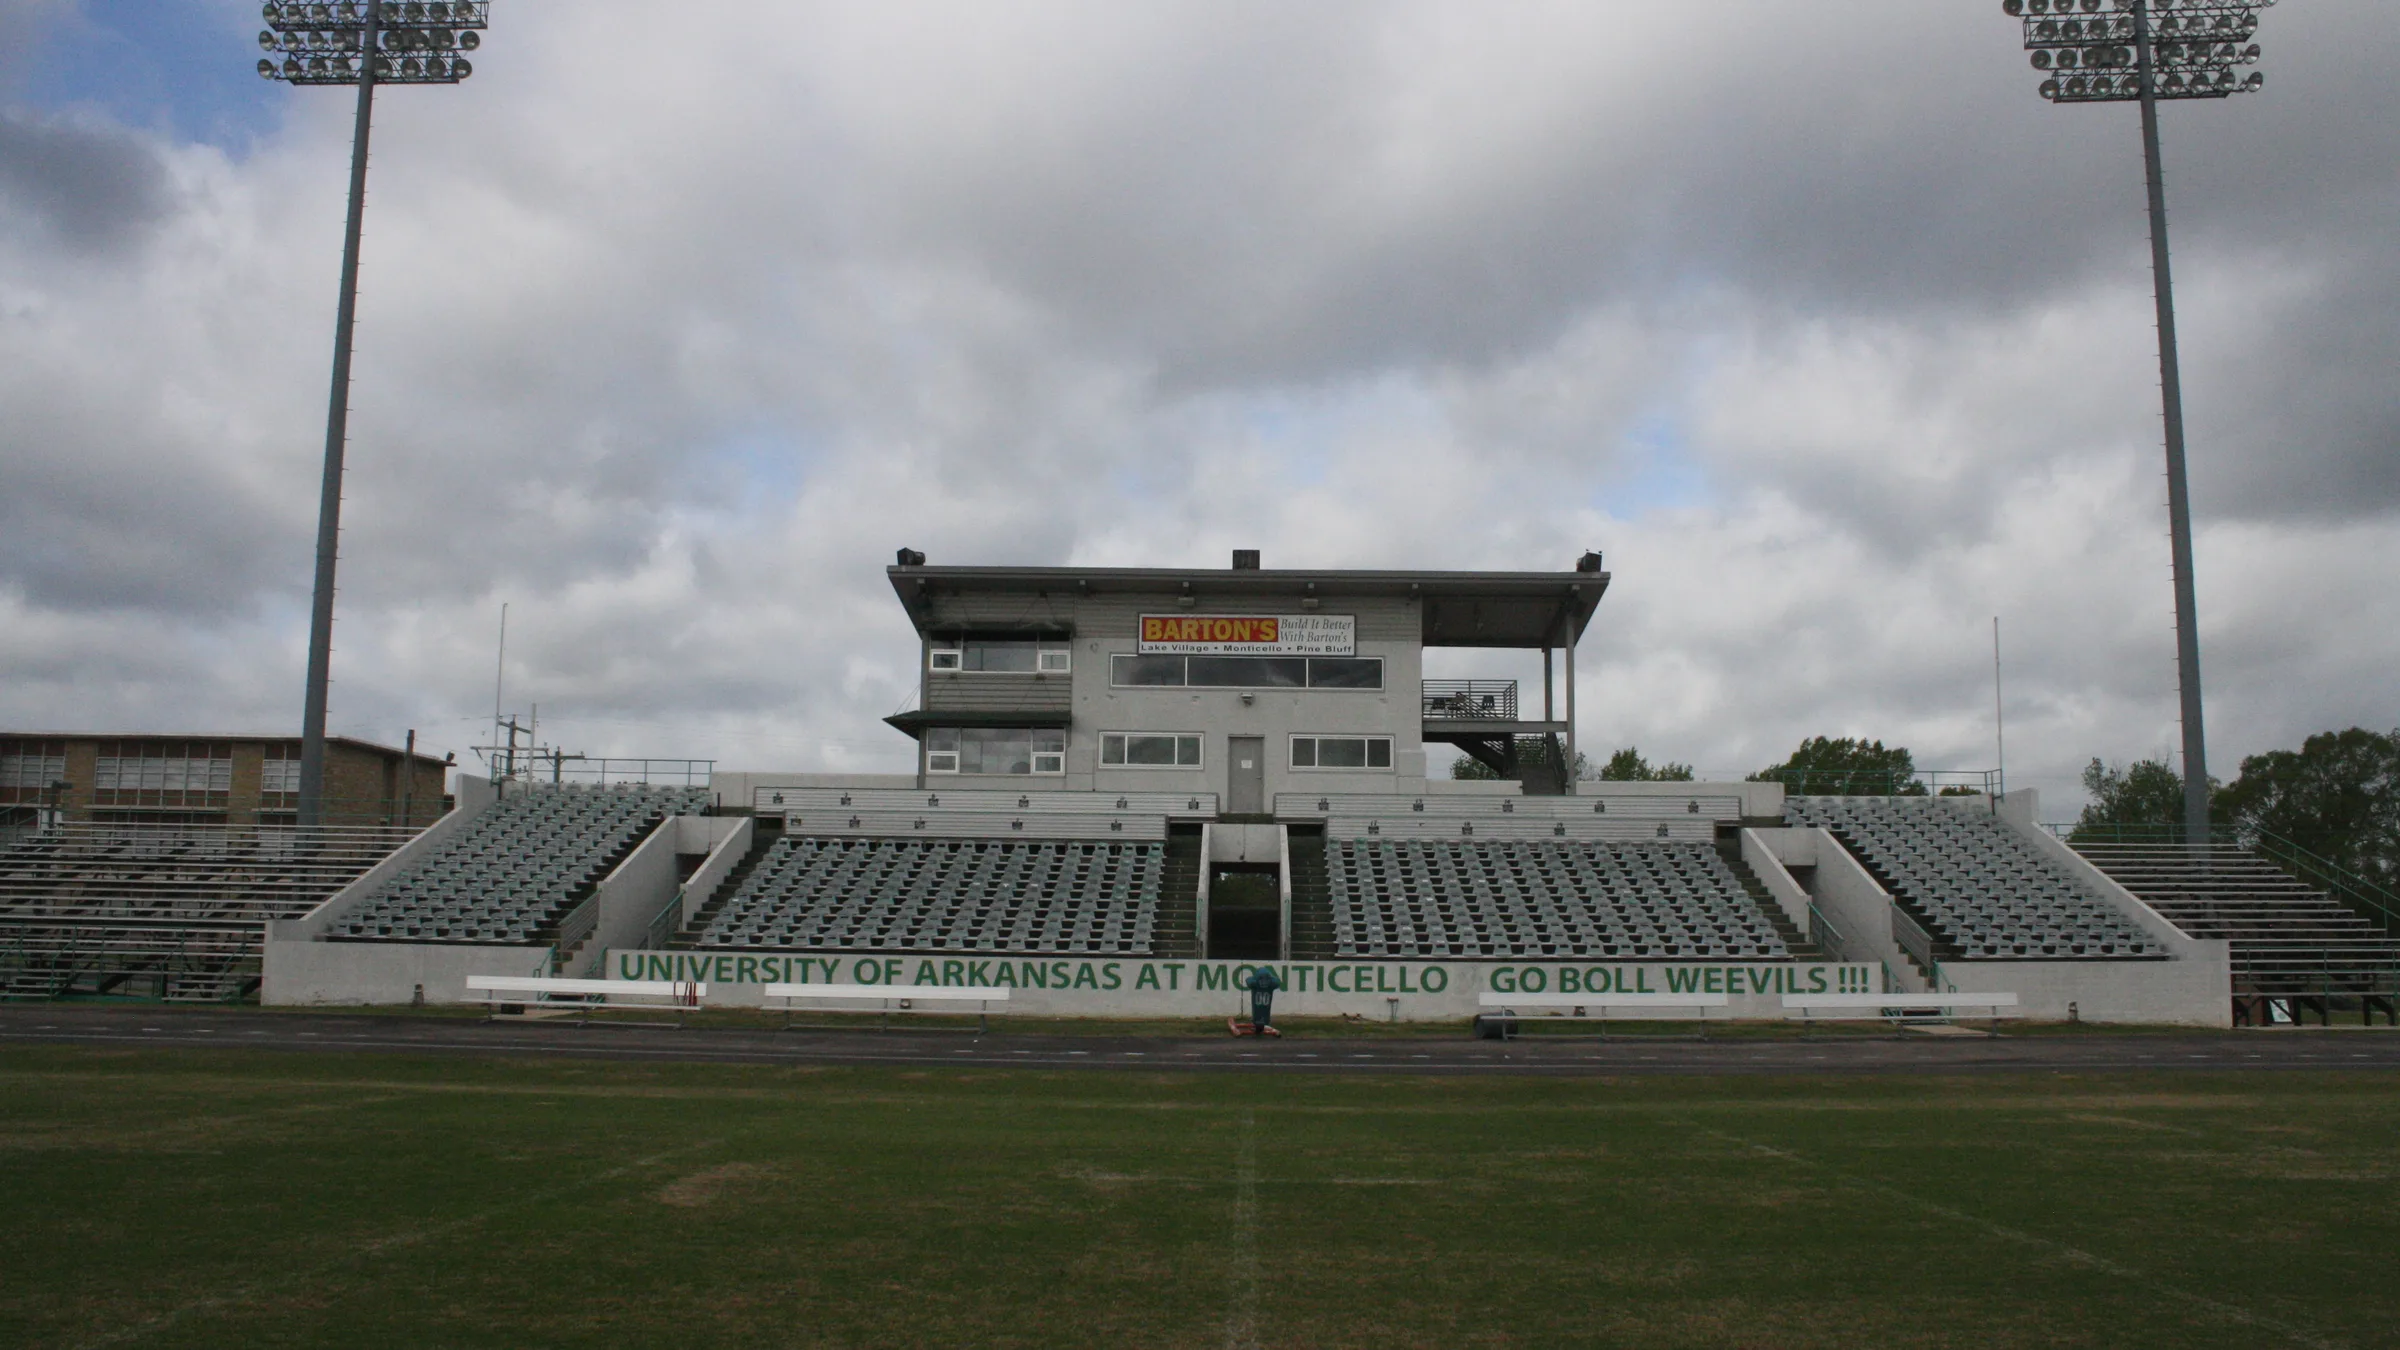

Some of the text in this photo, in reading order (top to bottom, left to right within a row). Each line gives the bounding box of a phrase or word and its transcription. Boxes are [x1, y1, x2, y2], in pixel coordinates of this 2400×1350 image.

[1145, 618, 1277, 641] BARTON'S
[1281, 618, 1352, 630] Build It Better
[1280, 631, 1347, 643] With Barton's
[1172, 644, 1209, 652] Village
[1325, 645, 1352, 653] Bluff
[620, 954, 1869, 994] UNIVERSITY OF ARKANSAS AT MONTICELLO GO BOLL WEEVILS !!!
